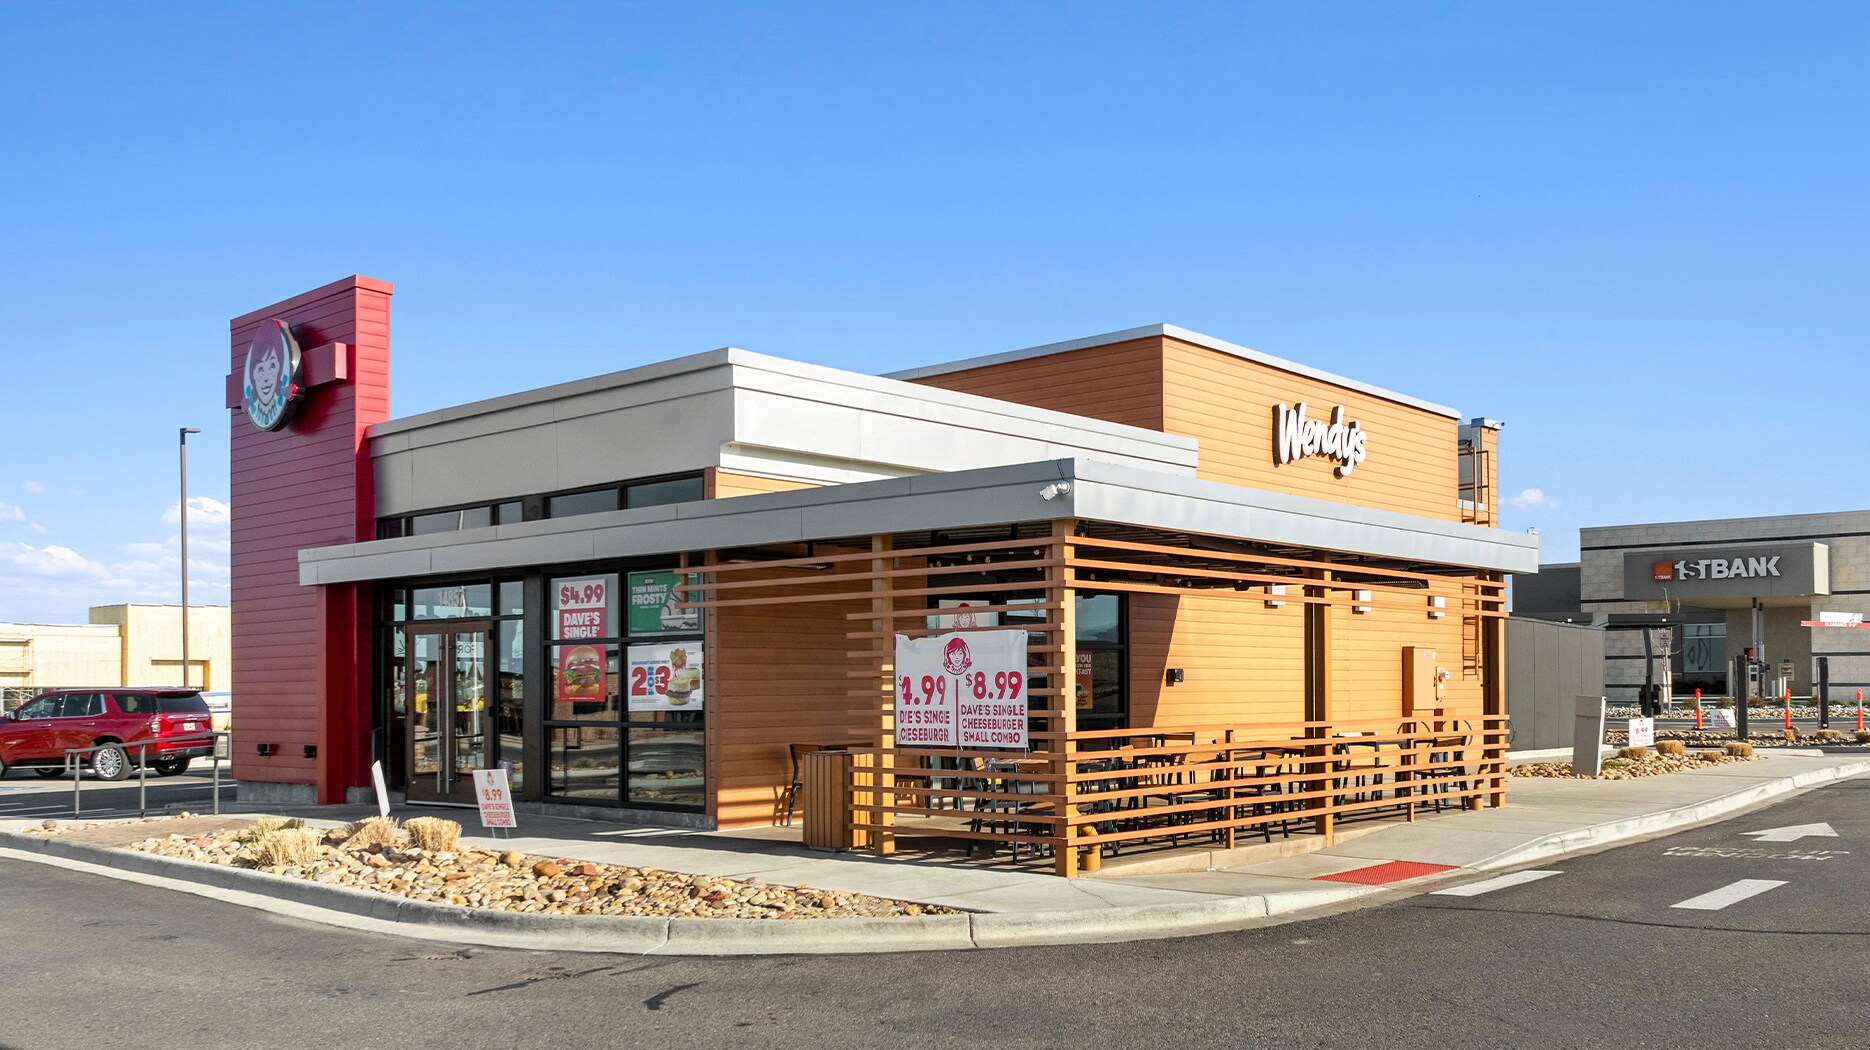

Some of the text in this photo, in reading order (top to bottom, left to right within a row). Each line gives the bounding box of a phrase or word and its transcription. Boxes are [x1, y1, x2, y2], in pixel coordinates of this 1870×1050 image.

[1273, 401, 1368, 477] Wendy's
[1674, 555, 1781, 581] 1STBANK
[560, 584, 604, 607] $4.99
[632, 584, 667, 594] THIN MINTS
[632, 592, 667, 606] FROSTY
[563, 611, 600, 627] DAVE'S
[563, 626, 599, 639] SINGLE
[631, 666, 648, 696] 2
[647, 666, 655, 696] FOR
[965, 671, 1023, 700] $8.99
[961, 704, 1025, 716] DAVE'S SINGLE
[961, 718, 1024, 730] CHEESEBURGER
[963, 731, 1021, 743] SMALL COMBO
[481, 788, 503, 801] $8.99
